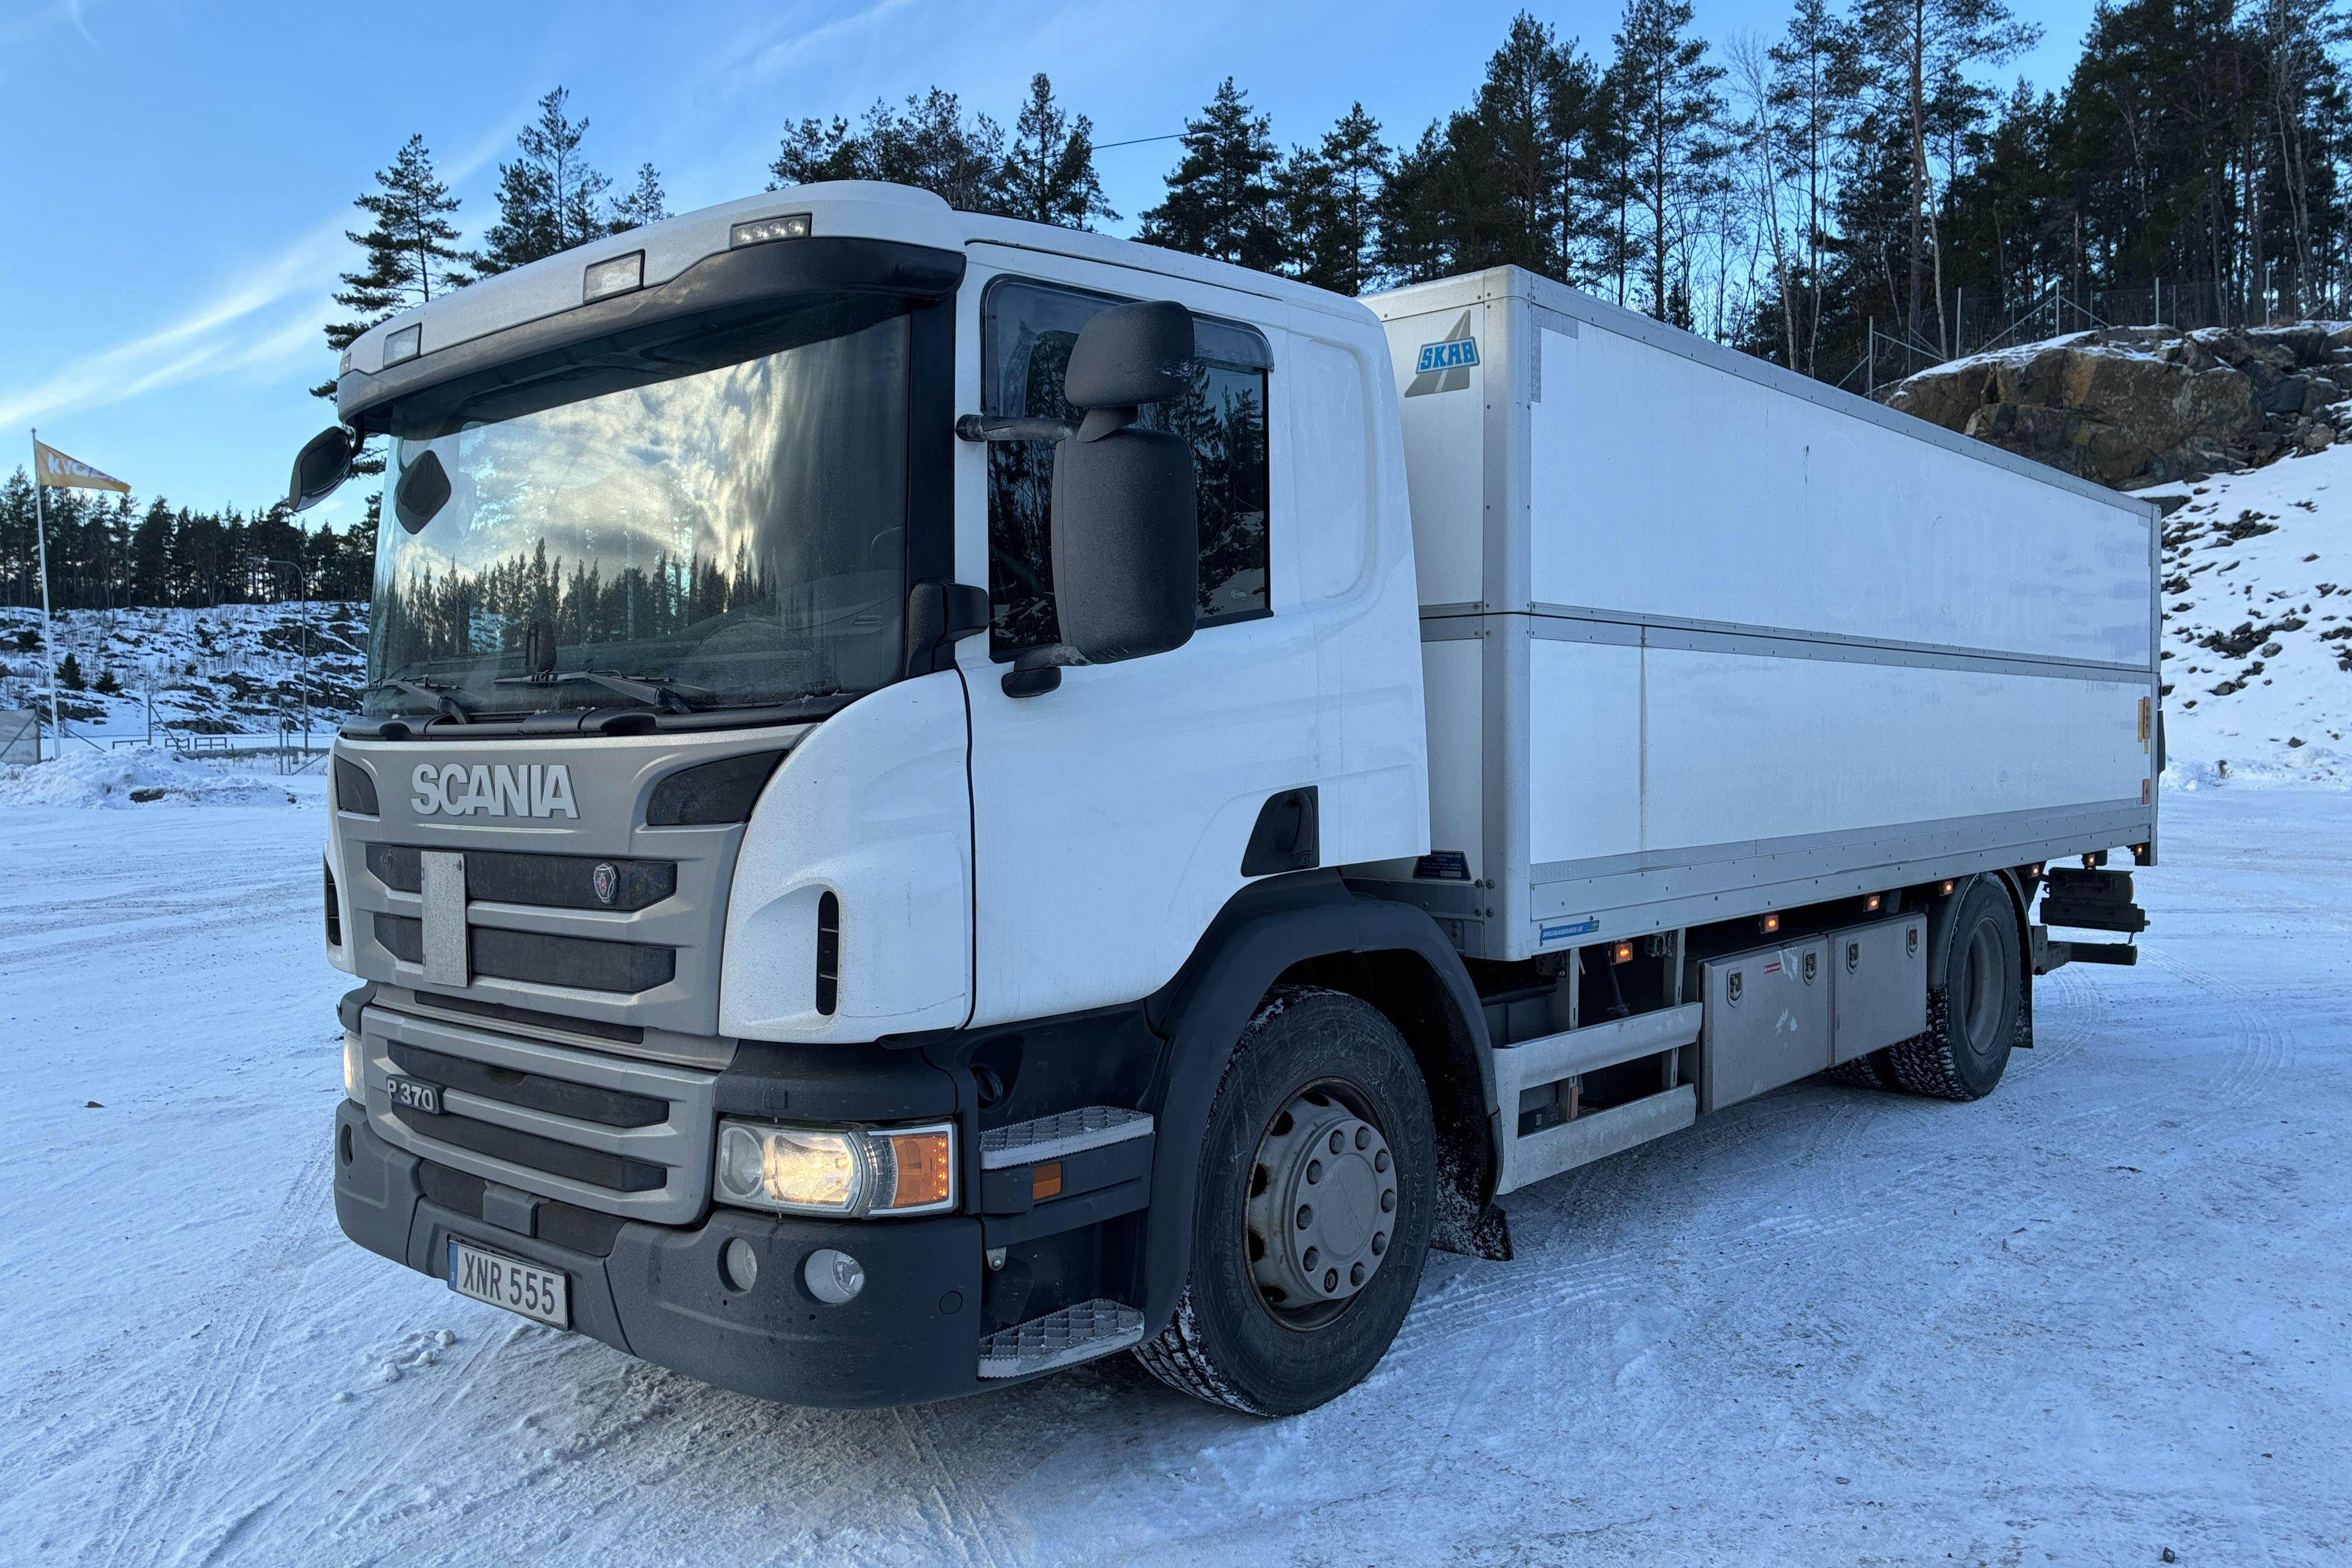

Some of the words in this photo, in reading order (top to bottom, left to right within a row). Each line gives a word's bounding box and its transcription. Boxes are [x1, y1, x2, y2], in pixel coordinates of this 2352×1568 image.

[1420, 342, 1475, 370] SKAB
[412, 764, 579, 820] SCANIA
[387, 1079, 397, 1099] P
[400, 1083, 433, 1111] 370
[451, 1270, 457, 1282] S
[463, 1252, 502, 1301] XNR
[509, 1267, 555, 1315] 555
